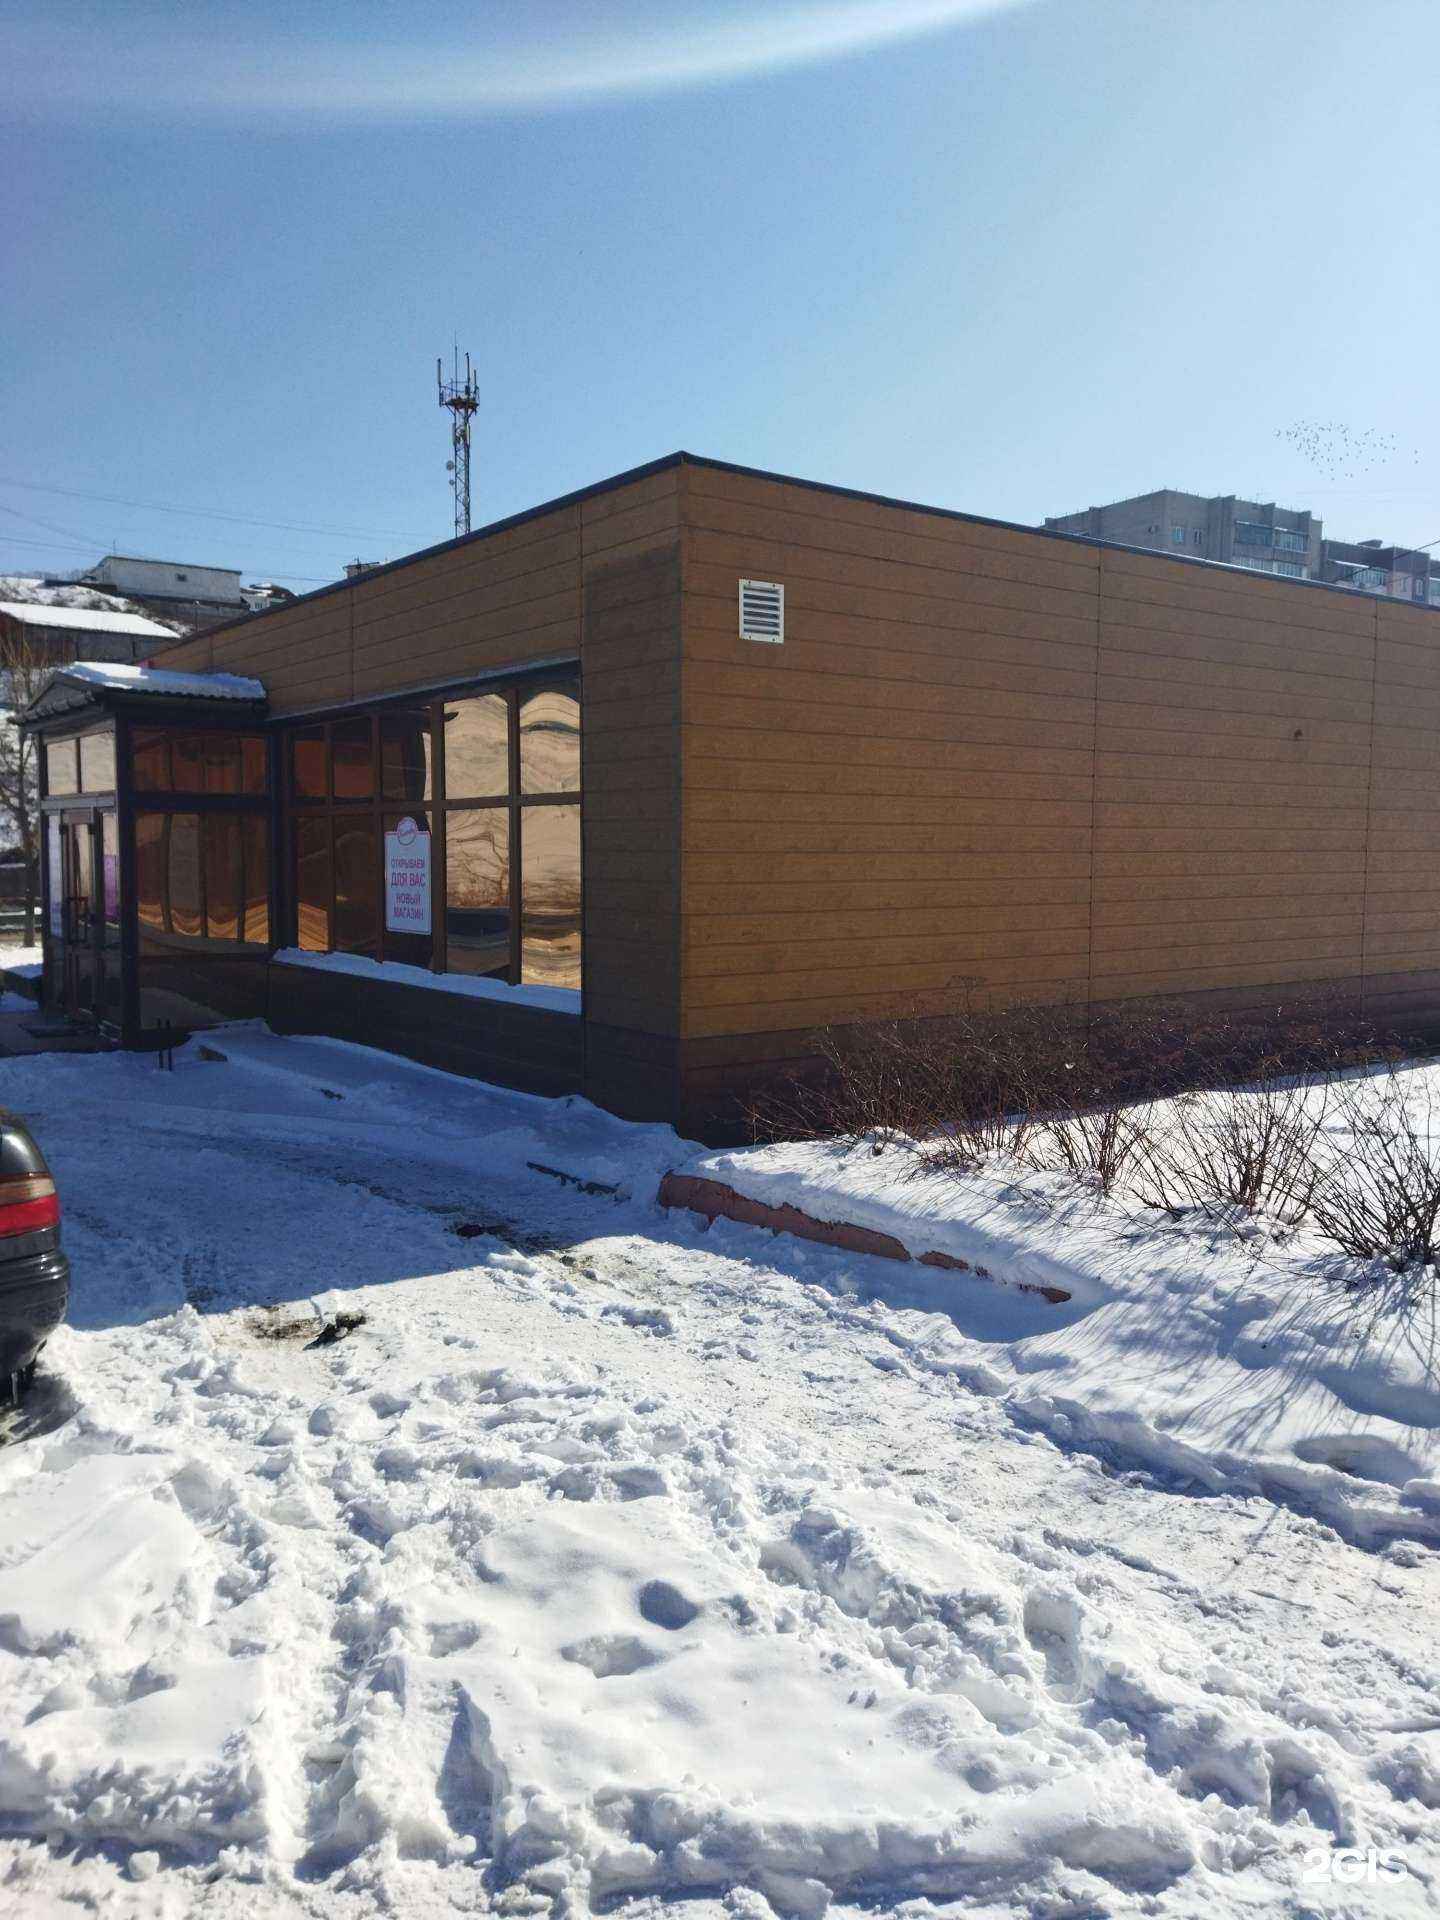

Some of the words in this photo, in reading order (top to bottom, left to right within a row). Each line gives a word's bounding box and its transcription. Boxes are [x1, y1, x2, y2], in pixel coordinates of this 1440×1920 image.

[391, 872, 407, 888] ДЛЯ
[409, 873, 425, 888] ВАС
[396, 893, 421, 905] НОВЫЙ
[393, 907, 424, 920] МАГАЗИН
